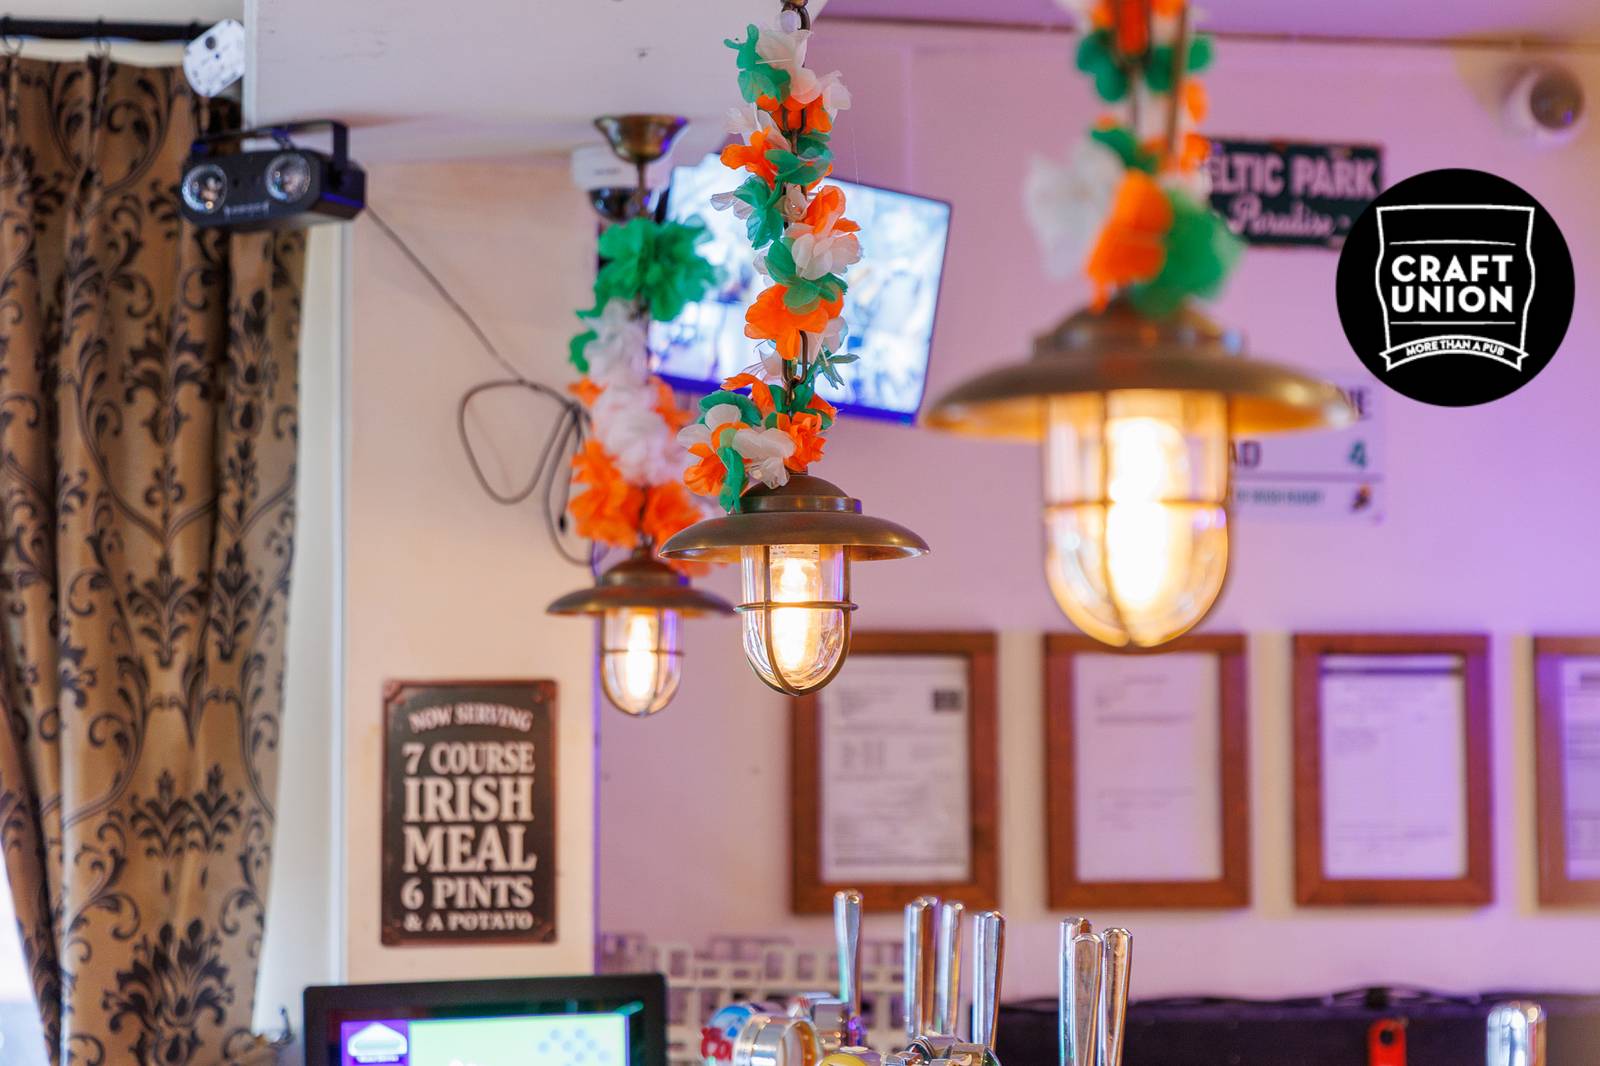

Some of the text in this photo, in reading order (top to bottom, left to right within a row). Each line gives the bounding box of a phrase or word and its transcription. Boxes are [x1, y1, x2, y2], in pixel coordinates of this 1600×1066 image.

[1209, 153, 1376, 199] ELTIC PARK
[408, 702, 533, 733] NOW SERVING
[403, 742, 535, 774] 7 COURSE
[403, 776, 534, 822] IRISH
[403, 825, 537, 873] MEAL
[401, 876, 534, 910] 6 PINTS
[404, 911, 533, 931] & A POTATO
